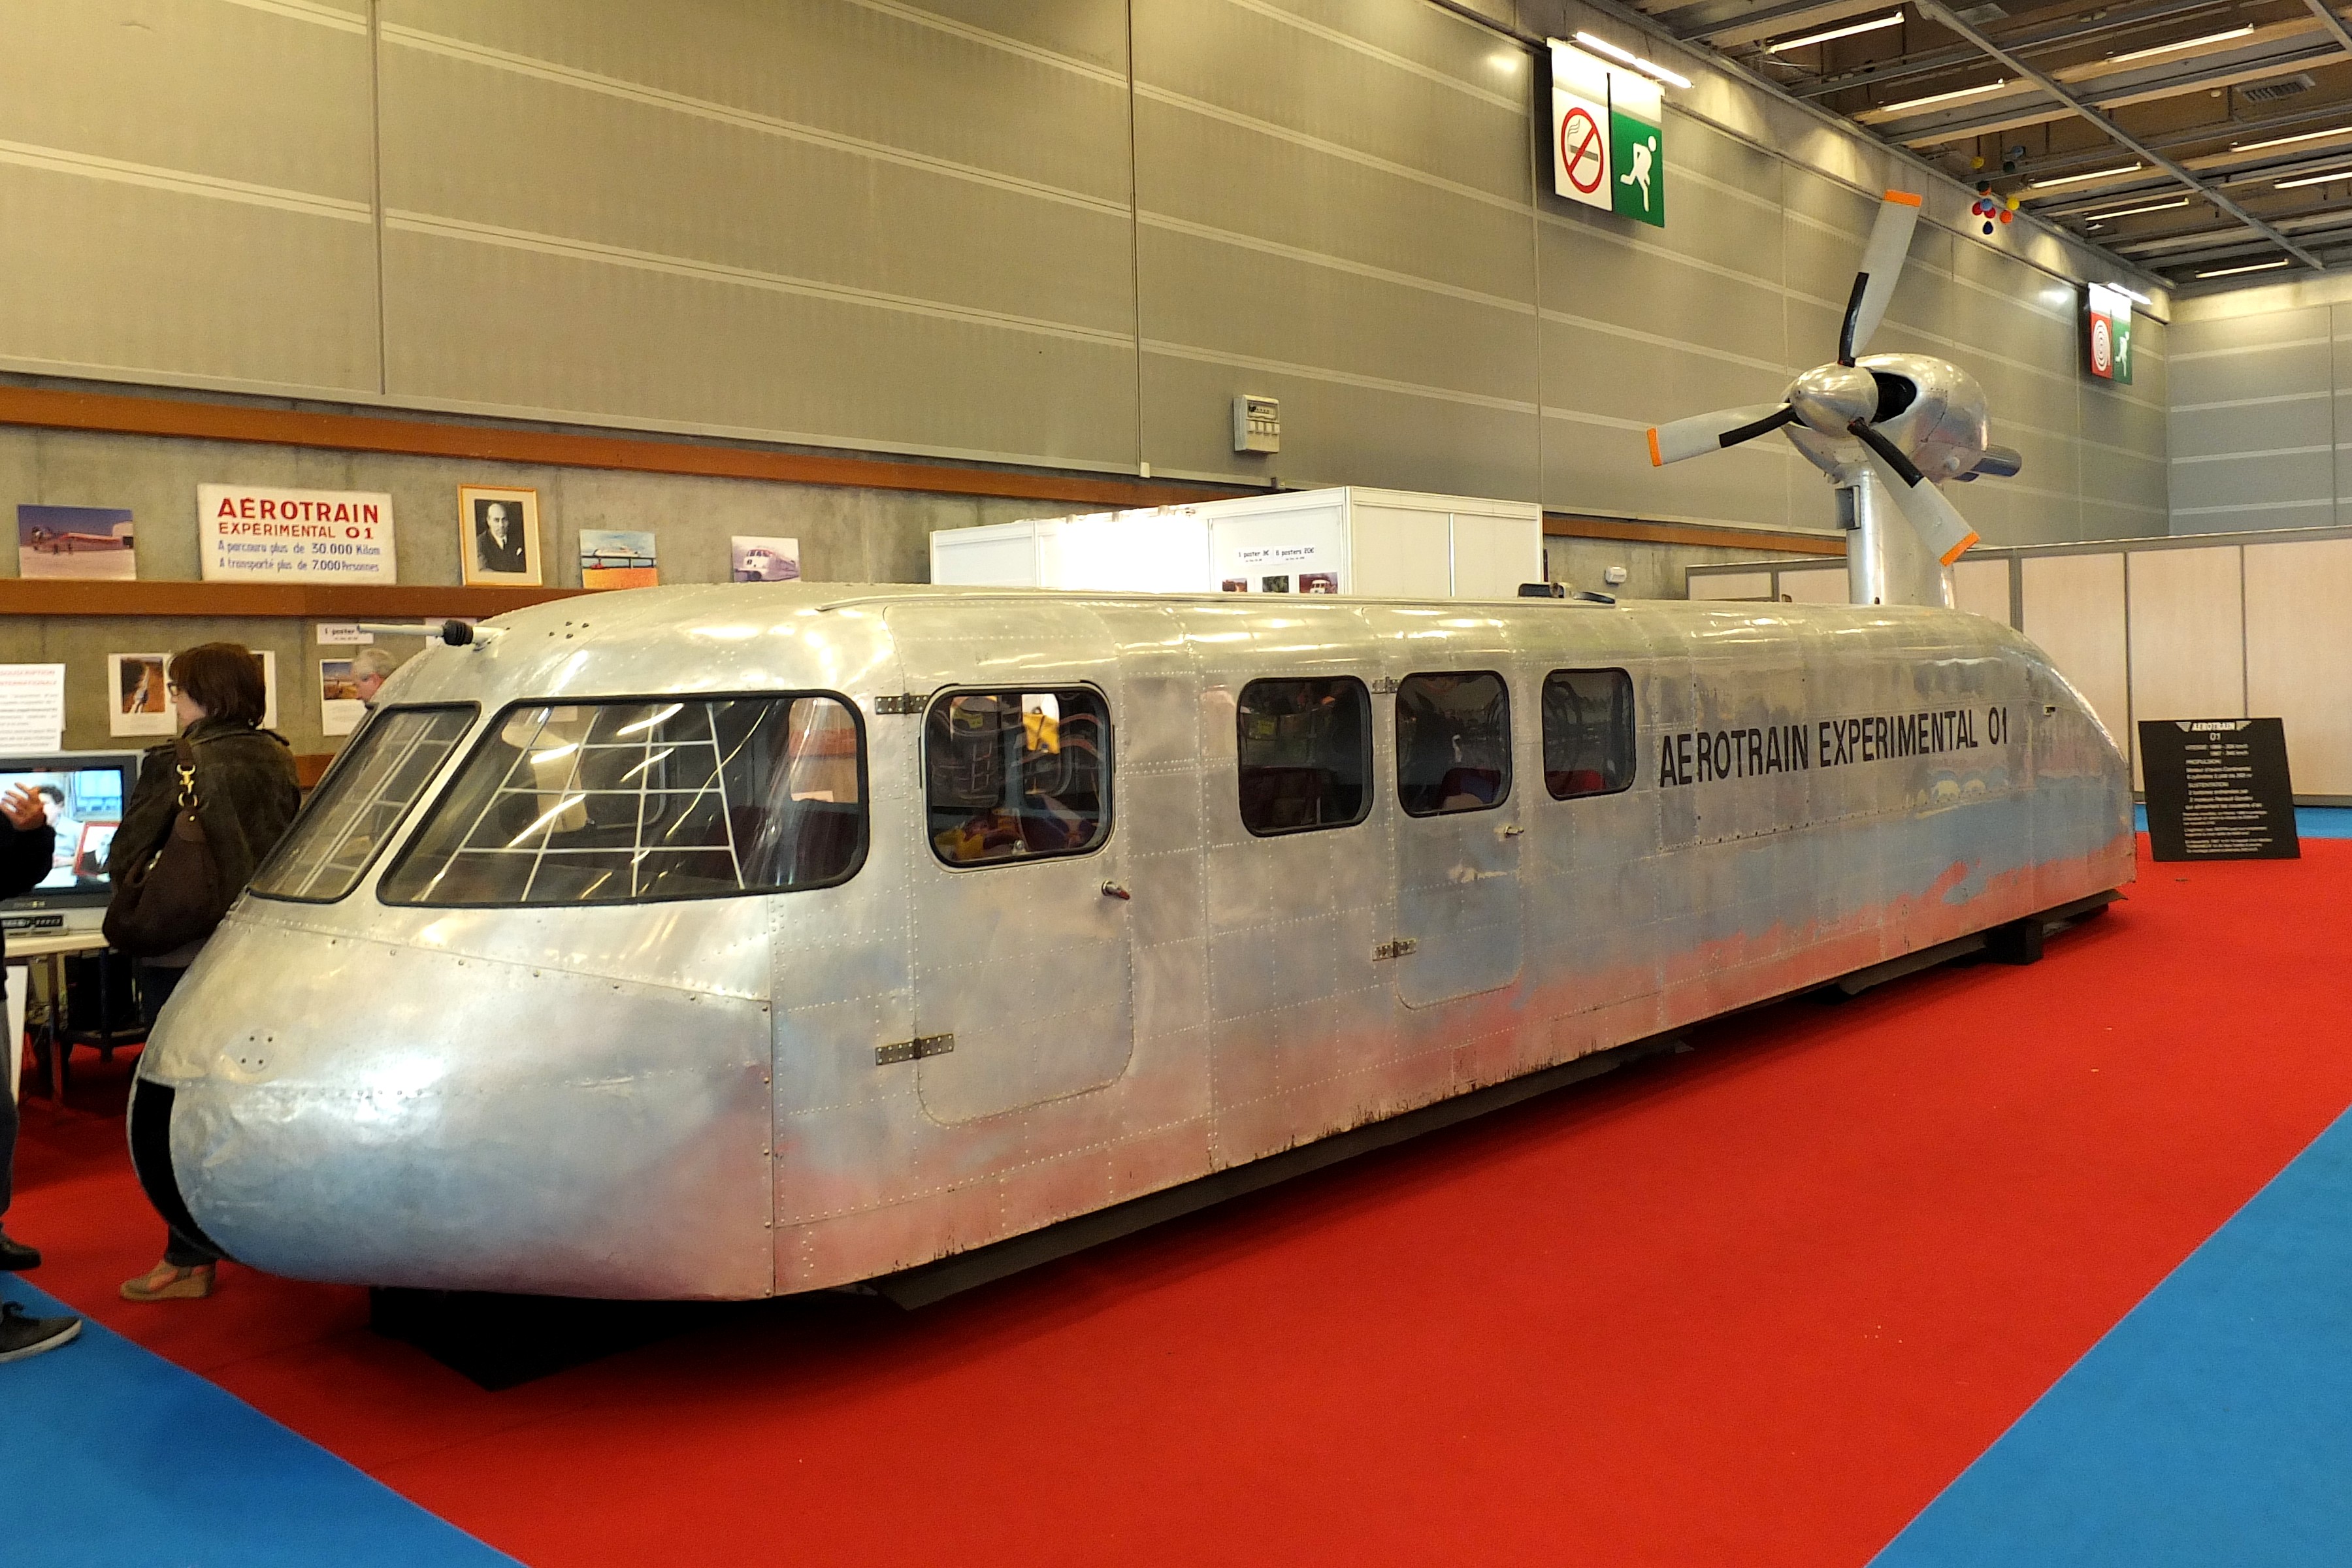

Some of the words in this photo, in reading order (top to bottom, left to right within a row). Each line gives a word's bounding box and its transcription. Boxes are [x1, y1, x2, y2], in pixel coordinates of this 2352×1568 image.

[270, 542, 287, 555] plus
[293, 543, 304, 553] de
[297, 559, 307, 570] de
[1659, 725, 1808, 787] AEROTRAIN
[1818, 709, 1978, 767] EXPERIMENTAL
